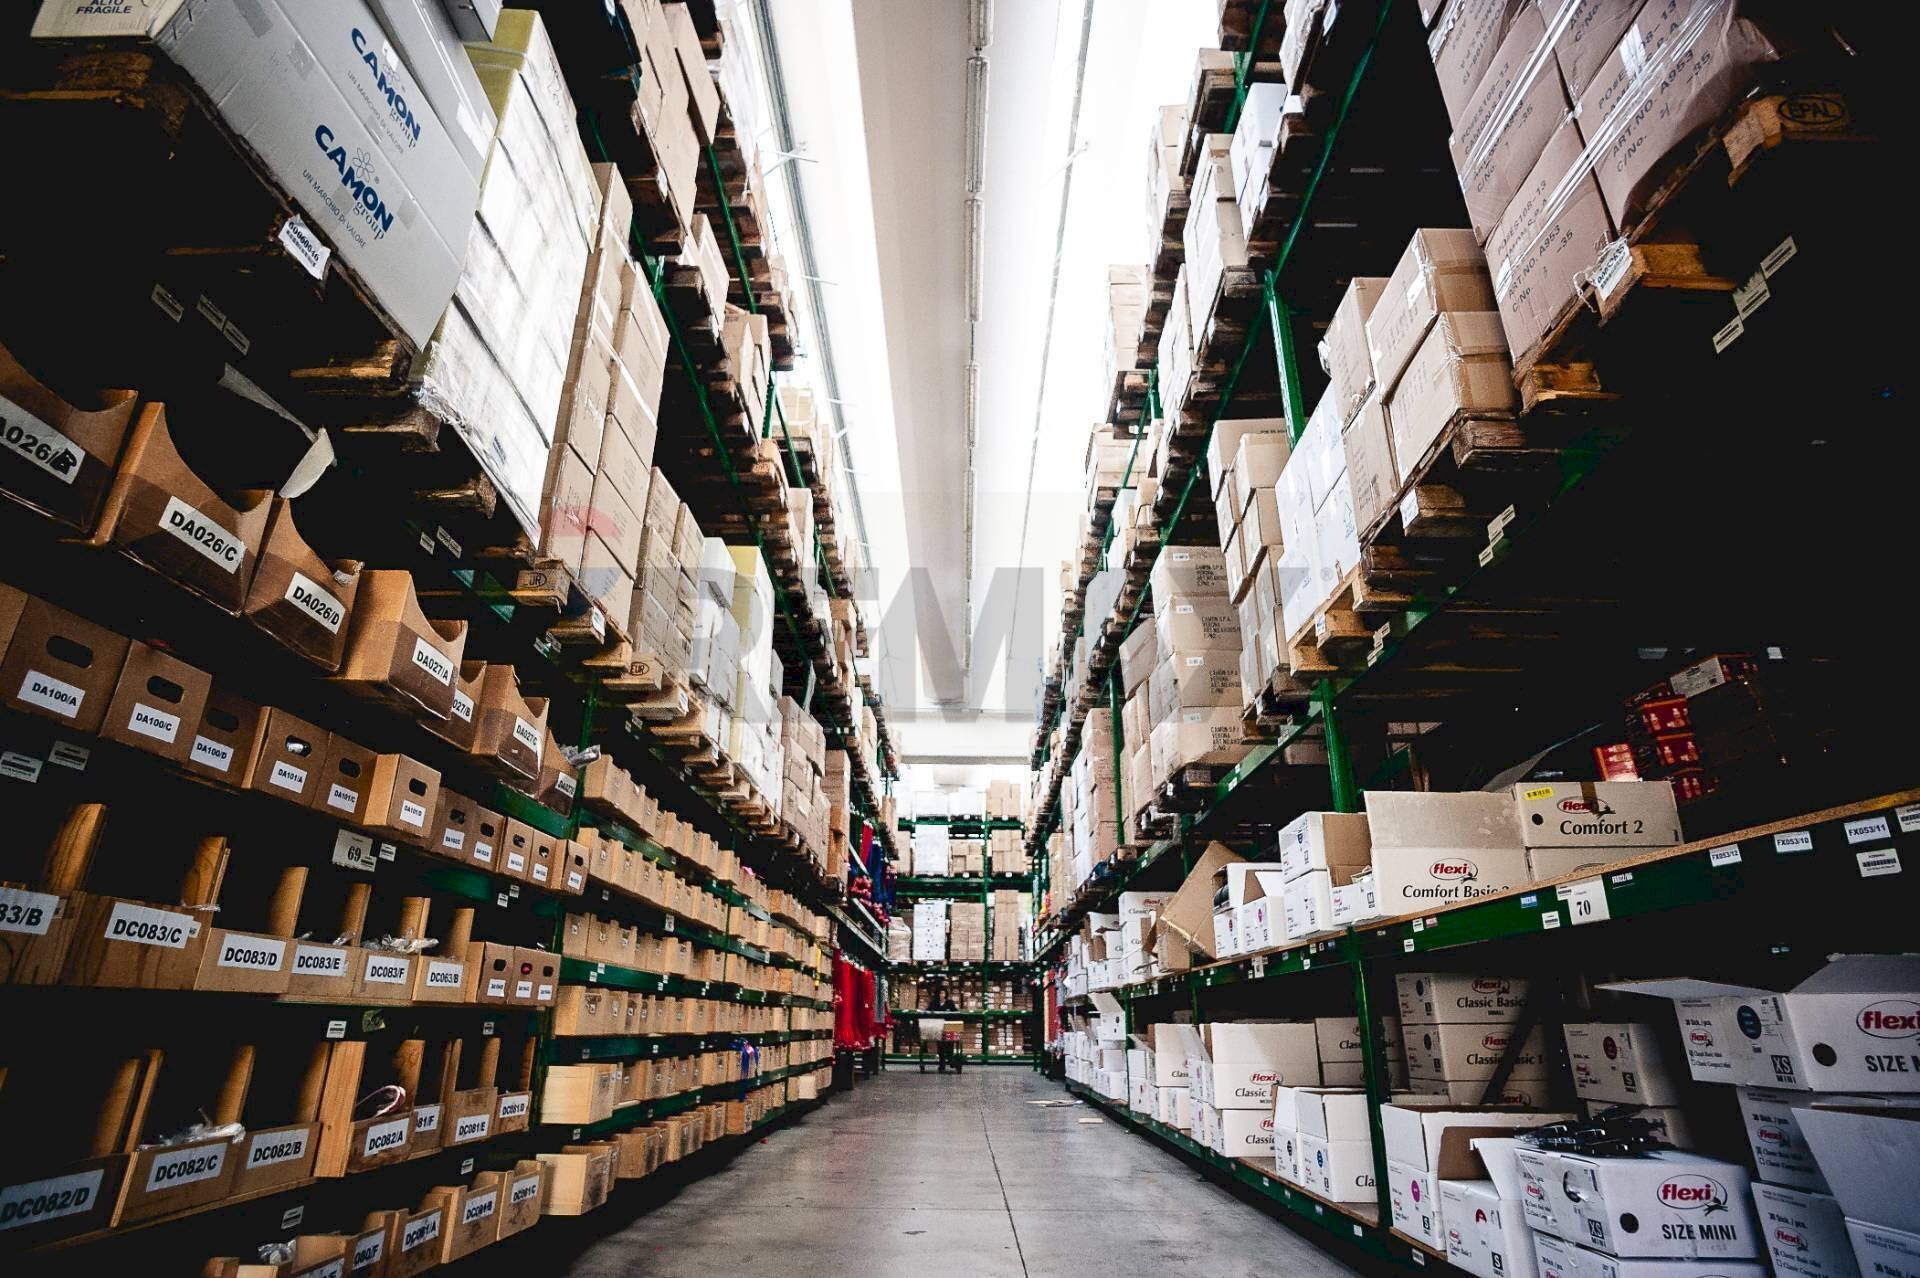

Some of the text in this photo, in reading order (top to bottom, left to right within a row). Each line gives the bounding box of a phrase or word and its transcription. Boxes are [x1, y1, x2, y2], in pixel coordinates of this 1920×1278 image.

[75, 6, 132, 14] FRAGILE
[352, 28, 421, 140] CAMON
[315, 125, 394, 232] CAMON
[302, 168, 313, 184] UN
[312, 181, 341, 217] MARCHIO
[346, 221, 367, 248] VALORE
[353, 201, 385, 240] group
[1538, 224, 1561, 257] A953
[169, 510, 238, 562] DA026/C
[292, 586, 340, 626] DA026/D
[416, 651, 450, 681] DA027/A
[31, 682, 78, 707] DA100/A
[135, 712, 173, 732] DA100/C
[196, 742, 228, 760] DA100/D
[1559, 820, 1644, 836] Comfort 2
[1848, 824, 1886, 836] FX053/11
[347, 845, 362, 862] 69
[1434, 863, 1469, 875] flexi
[1402, 885, 1460, 899] Comfort
[1576, 900, 1591, 916] 70
[113, 918, 183, 943] DC083/C
[224, 947, 278, 966] DC083/D
[297, 955, 341, 970] DC083/E
[370, 965, 405, 979] DC083/F
[1456, 996, 1493, 1008] Classic
[1690, 1032, 1708, 1041] flexi
[1774, 1055, 1791, 1073] XS
[1864, 1054, 1910, 1073] SIZE
[1252, 1073, 1277, 1081] flexi
[1235, 1088, 1267, 1097] Classic
[459, 1121, 486, 1136] DC081/E
[369, 1129, 404, 1151] DC082/A
[253, 1141, 301, 1163] DC082/B
[154, 1155, 218, 1183] DC082/C
[1661, 1183, 1712, 1201] flexi
[1591, 1220, 1603, 1237] XS
[1661, 1224, 1737, 1241] SIZE MINI
[1776, 1230, 1801, 1243] flexi
